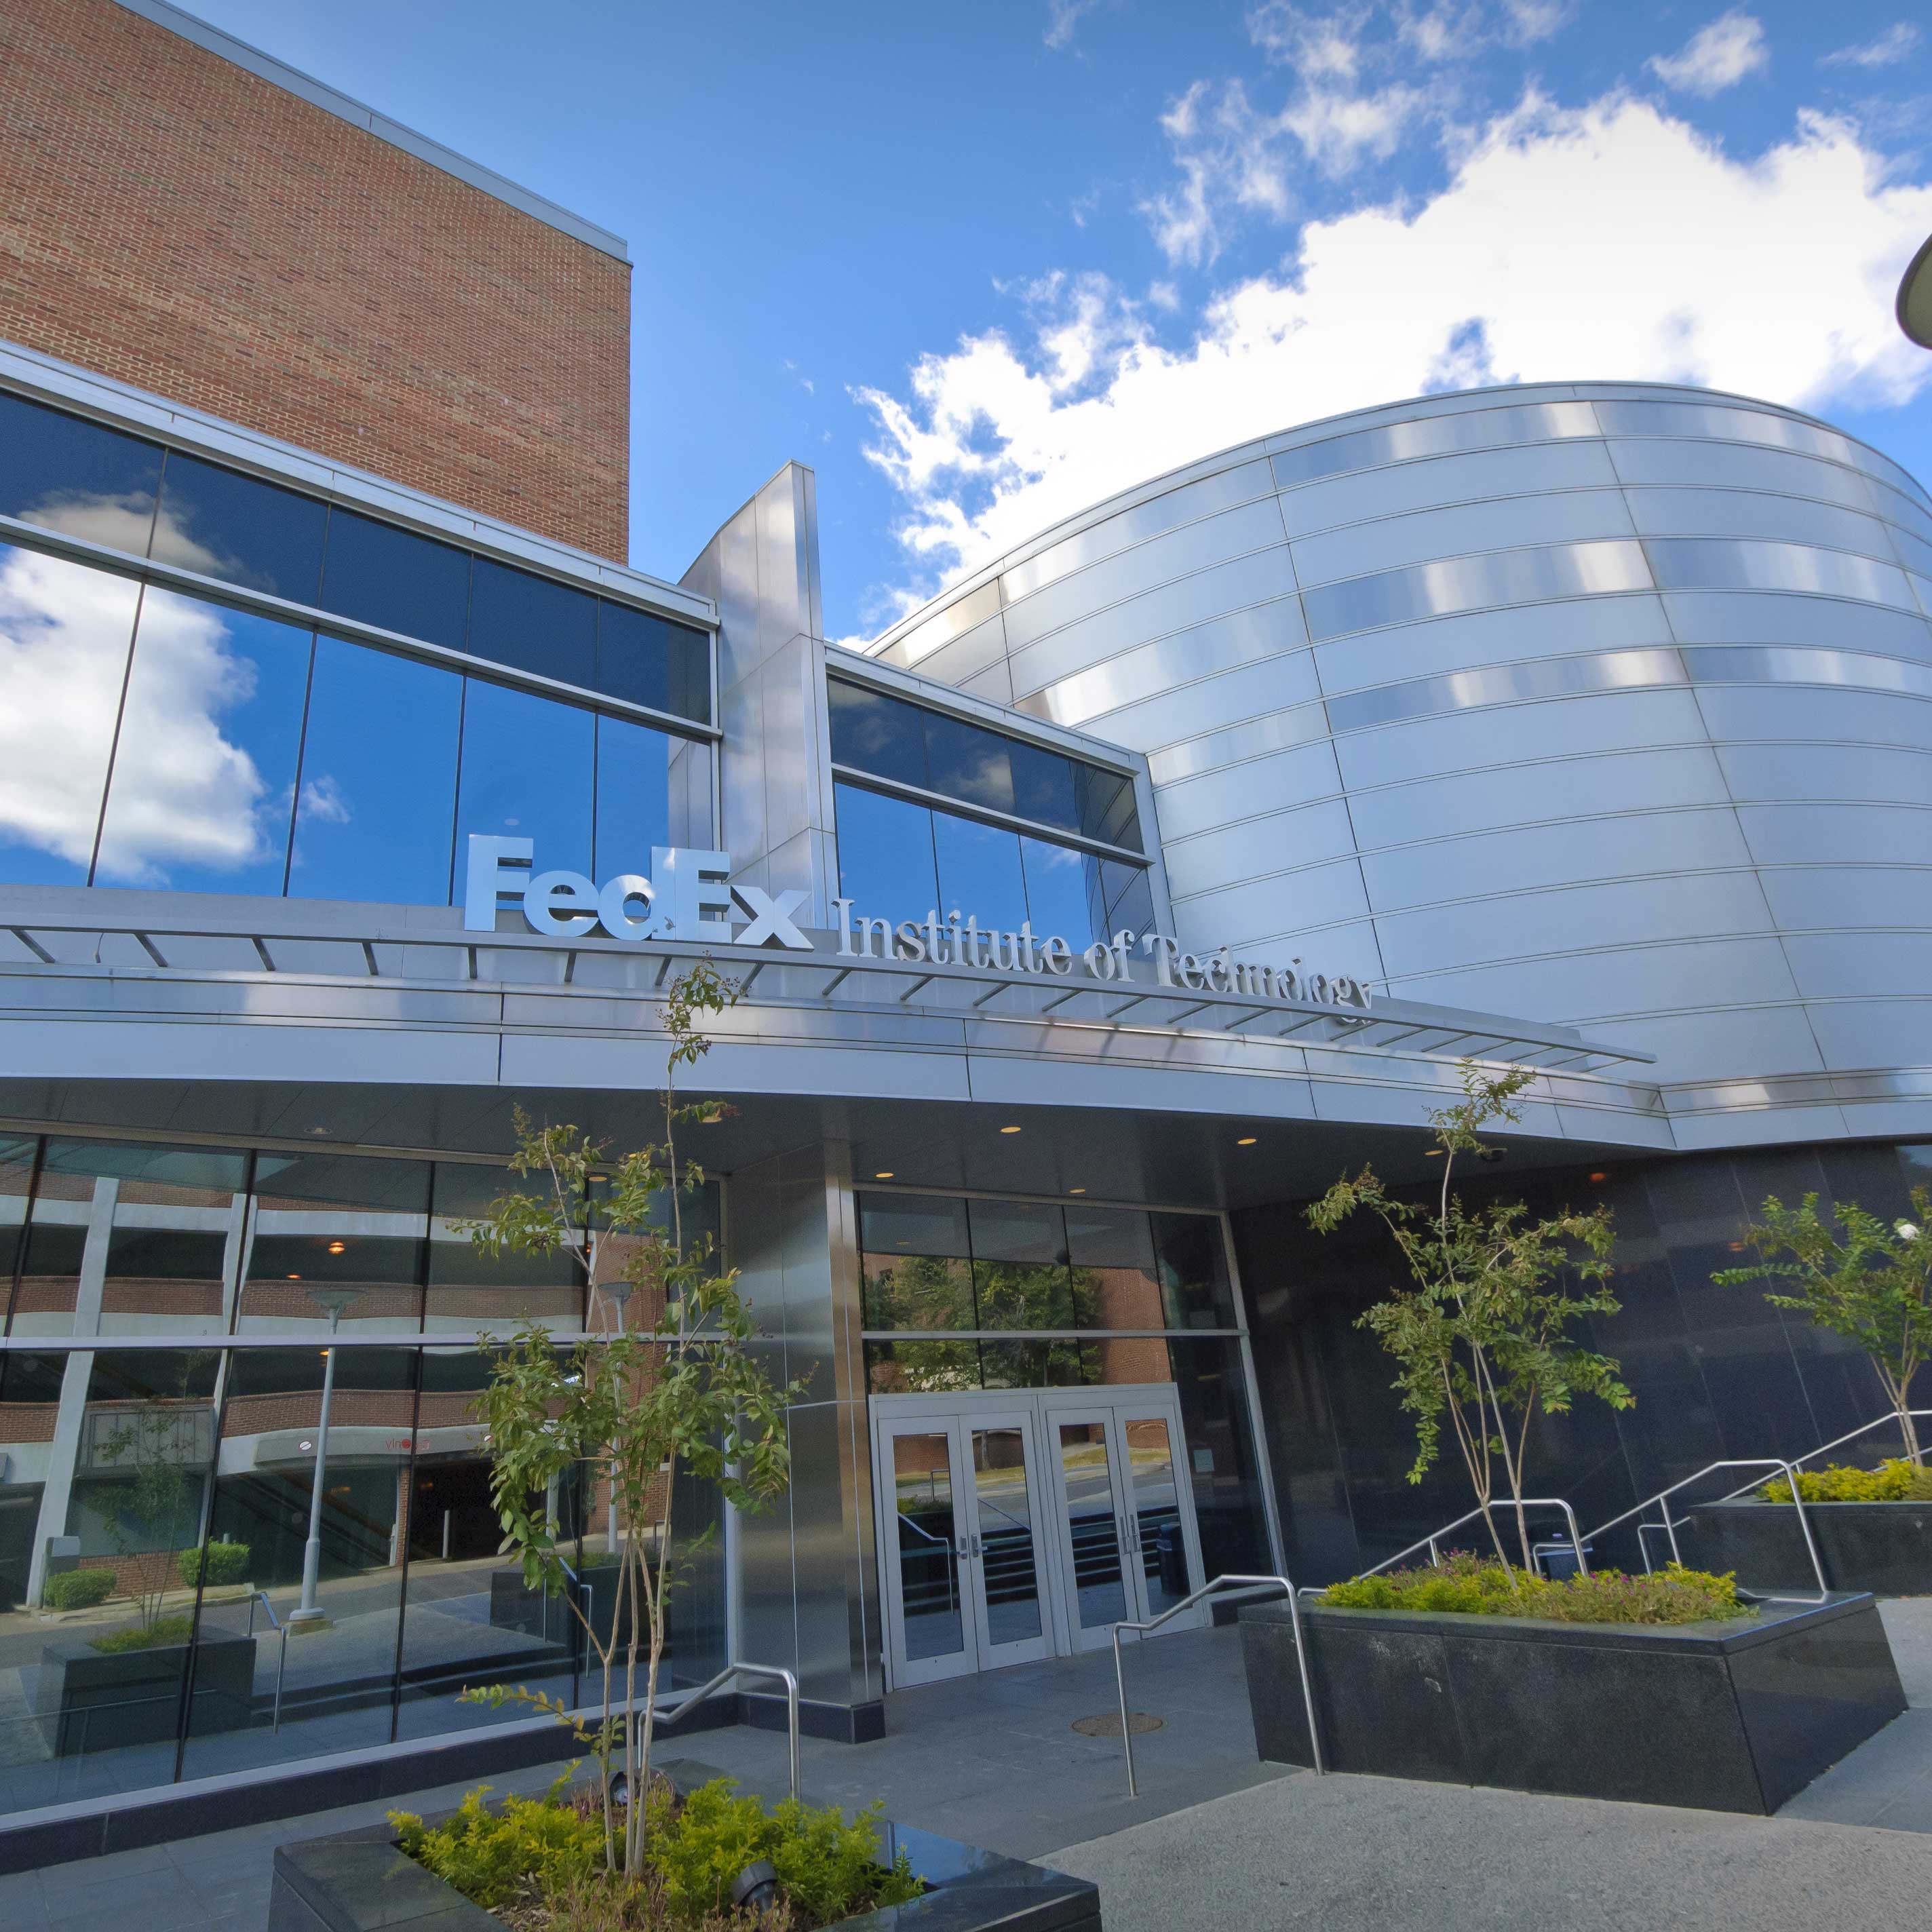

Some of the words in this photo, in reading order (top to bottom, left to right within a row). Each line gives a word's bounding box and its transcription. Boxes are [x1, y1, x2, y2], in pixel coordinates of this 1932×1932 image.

[464, 833, 814, 950] FedEx
[831, 897, 1073, 975] Institute
[1083, 929, 1136, 983] of
[1142, 933, 1372, 1026] Technology
